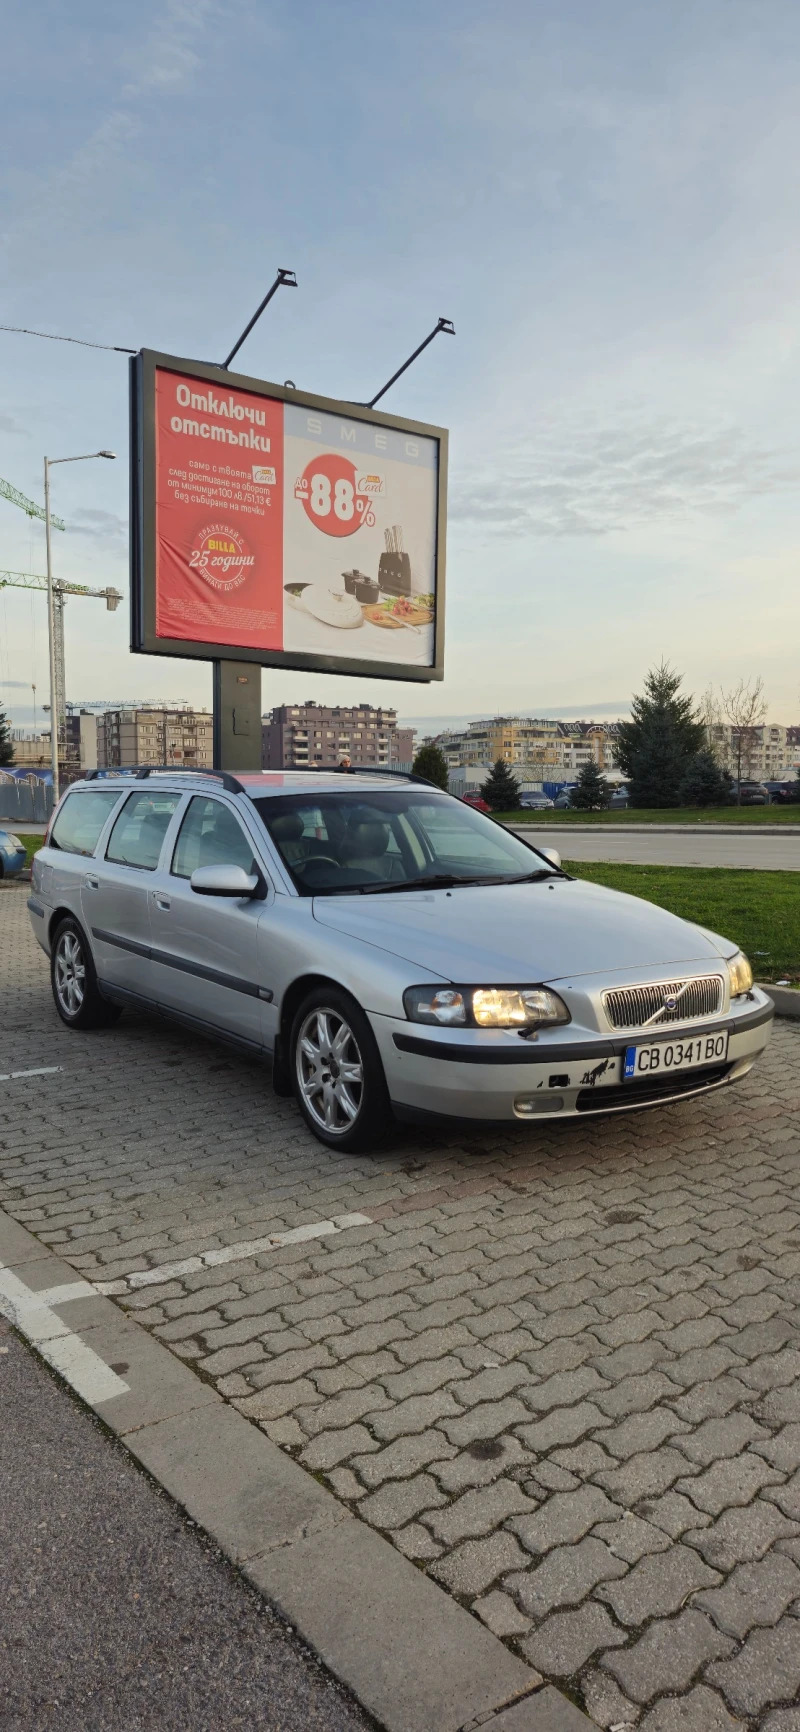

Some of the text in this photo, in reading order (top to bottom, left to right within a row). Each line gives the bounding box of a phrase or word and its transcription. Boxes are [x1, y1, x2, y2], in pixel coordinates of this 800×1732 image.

[176, 384, 266, 427] Отключи
[170, 416, 271, 453] отстъпки
[306, 417, 419, 458] SMEG
[168, 468, 271, 496] след достигане на оборот
[189, 460, 210, 471] само
[218, 466, 252, 480] твоята
[167, 479, 180, 488] от
[181, 483, 218, 497] минимум
[219, 488, 233, 499] 100
[174, 490, 265, 516] без събиране на точки
[208, 539, 236, 554] BILLA
[189, 550, 255, 573] 25 години
[637, 1036, 724, 1071] CB 0341 BO
[625, 1064, 634, 1073] BG
